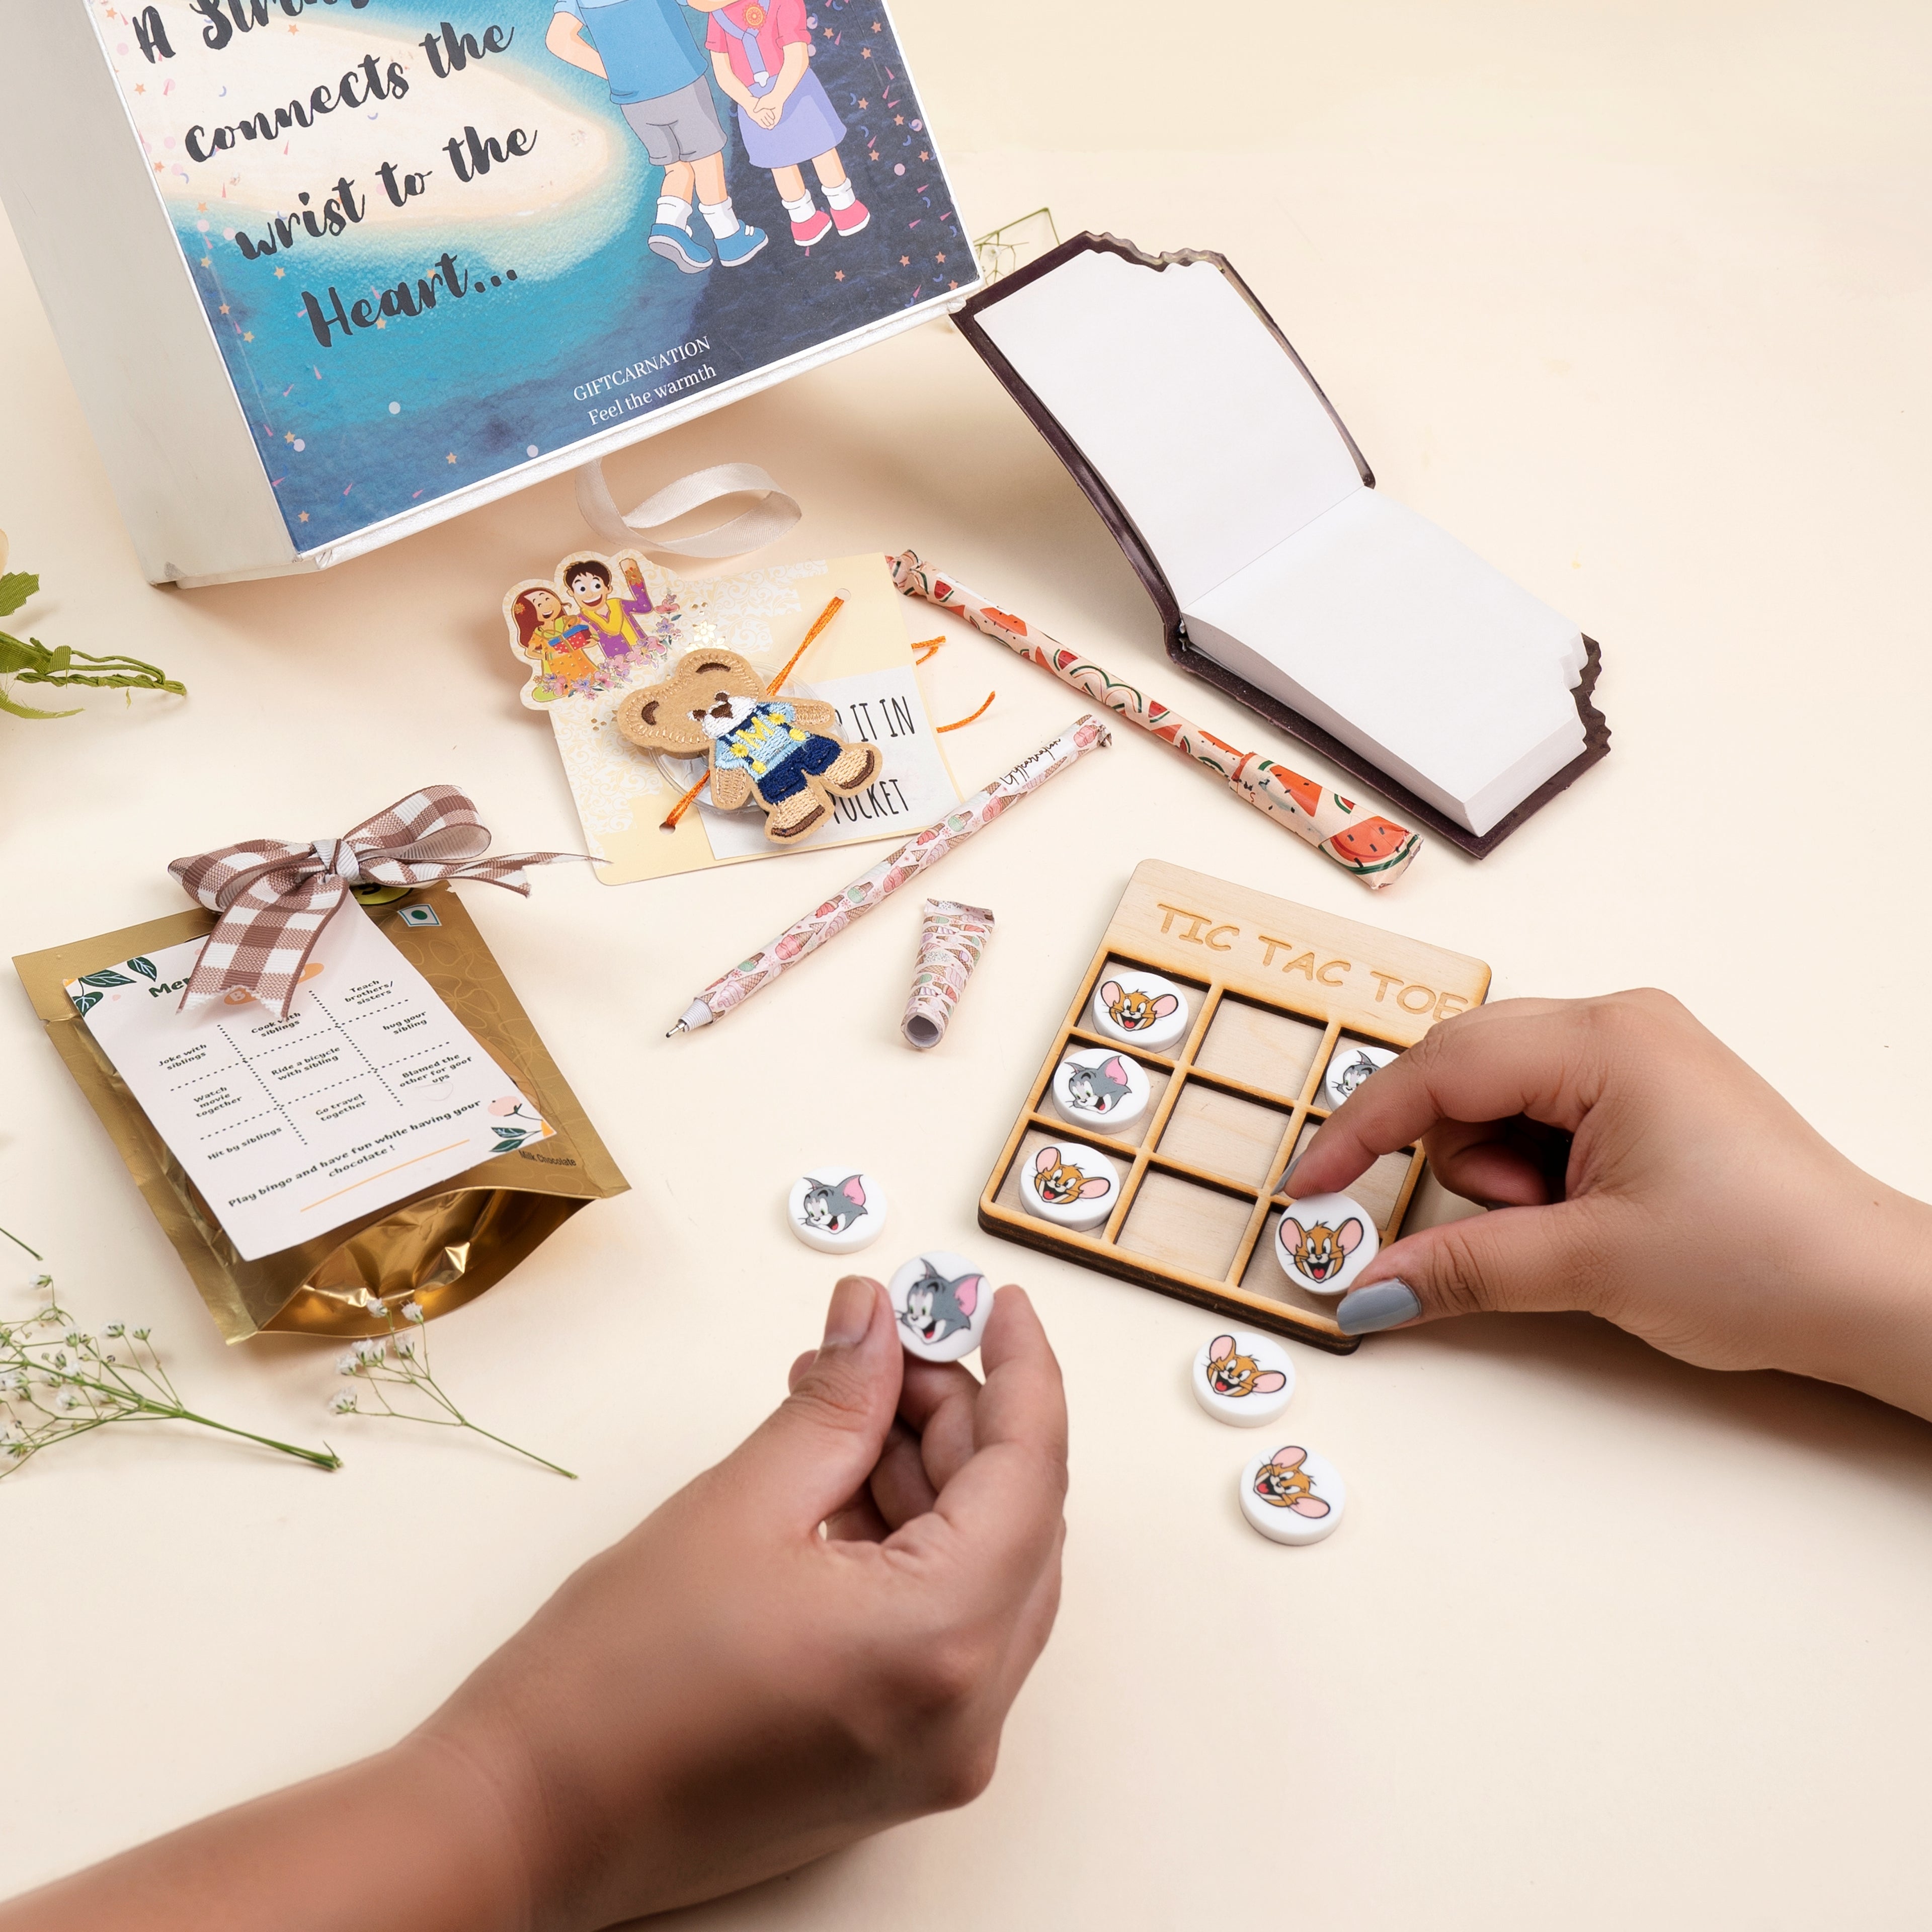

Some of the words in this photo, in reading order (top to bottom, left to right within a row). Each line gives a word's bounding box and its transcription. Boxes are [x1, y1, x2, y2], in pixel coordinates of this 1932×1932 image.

[132, 6, 176, 64] A
[185, 54, 409, 162] connects
[419, 22, 514, 78] the
[235, 178, 365, 260] wrist
[375, 162, 432, 206] to
[443, 126, 538, 182] the
[301, 253, 518, 348] Heart...
[574, 336, 711, 401] GIFTCARNATION
[587, 400, 624, 426] Feel
[625, 389, 653, 410] the
[654, 364, 717, 398] warmth
[850, 703, 877, 742] IT
[879, 696, 915, 737] IN
[1157, 903, 1239, 951] TIC
[1258, 935, 1351, 987] TAC
[1370, 971, 1468, 1022] TOE
[345, 981, 393, 1003] brothers/
[349, 980, 379, 993] Teach
[357, 990, 391, 1005] sisters
[252, 1022, 276, 1033] Cook
[261, 1020, 300, 1037] siblings
[382, 1021, 403, 1031] hug
[403, 1011, 426, 1024] your
[393, 1019, 427, 1035] sibling
[158, 1055, 182, 1067] Joke
[183, 1044, 207, 1056] with
[167, 1051, 206, 1070] siblings
[271, 1065, 294, 1076] Ride
[304, 1046, 341, 1064] bicycle
[402, 1061, 440, 1078] Blamed
[442, 1054, 460, 1064] the
[278, 1068, 302, 1081] with
[304, 1055, 339, 1071] sibling
[399, 1074, 428, 1088] other
[431, 1066, 447, 1077] for
[450, 1057, 472, 1070] goof
[432, 1074, 450, 1085] ups
[193, 1086, 227, 1103] Watch
[200, 1093, 230, 1108] movie
[315, 1107, 330, 1116] Go
[331, 1093, 363, 1111] travel
[196, 1096, 243, 1117] together
[320, 1099, 368, 1122] together
[207, 1150, 224, 1160] Hit
[226, 1144, 240, 1154] by
[242, 1127, 282, 1147] siblings
[228, 1192, 257, 1208] Play
[259, 1176, 292, 1195] bingo
[295, 1165, 318, 1180] and
[319, 1151, 349, 1168] have
[350, 1142, 373, 1156] fun
[374, 1127, 408, 1146] while
[410, 1113, 452, 1133] having
[453, 1100, 482, 1116] your
[329, 1148, 388, 1178] chocolate
[519, 1150, 537, 1162] Milk
[536, 1154, 577, 1166] Chocolate
